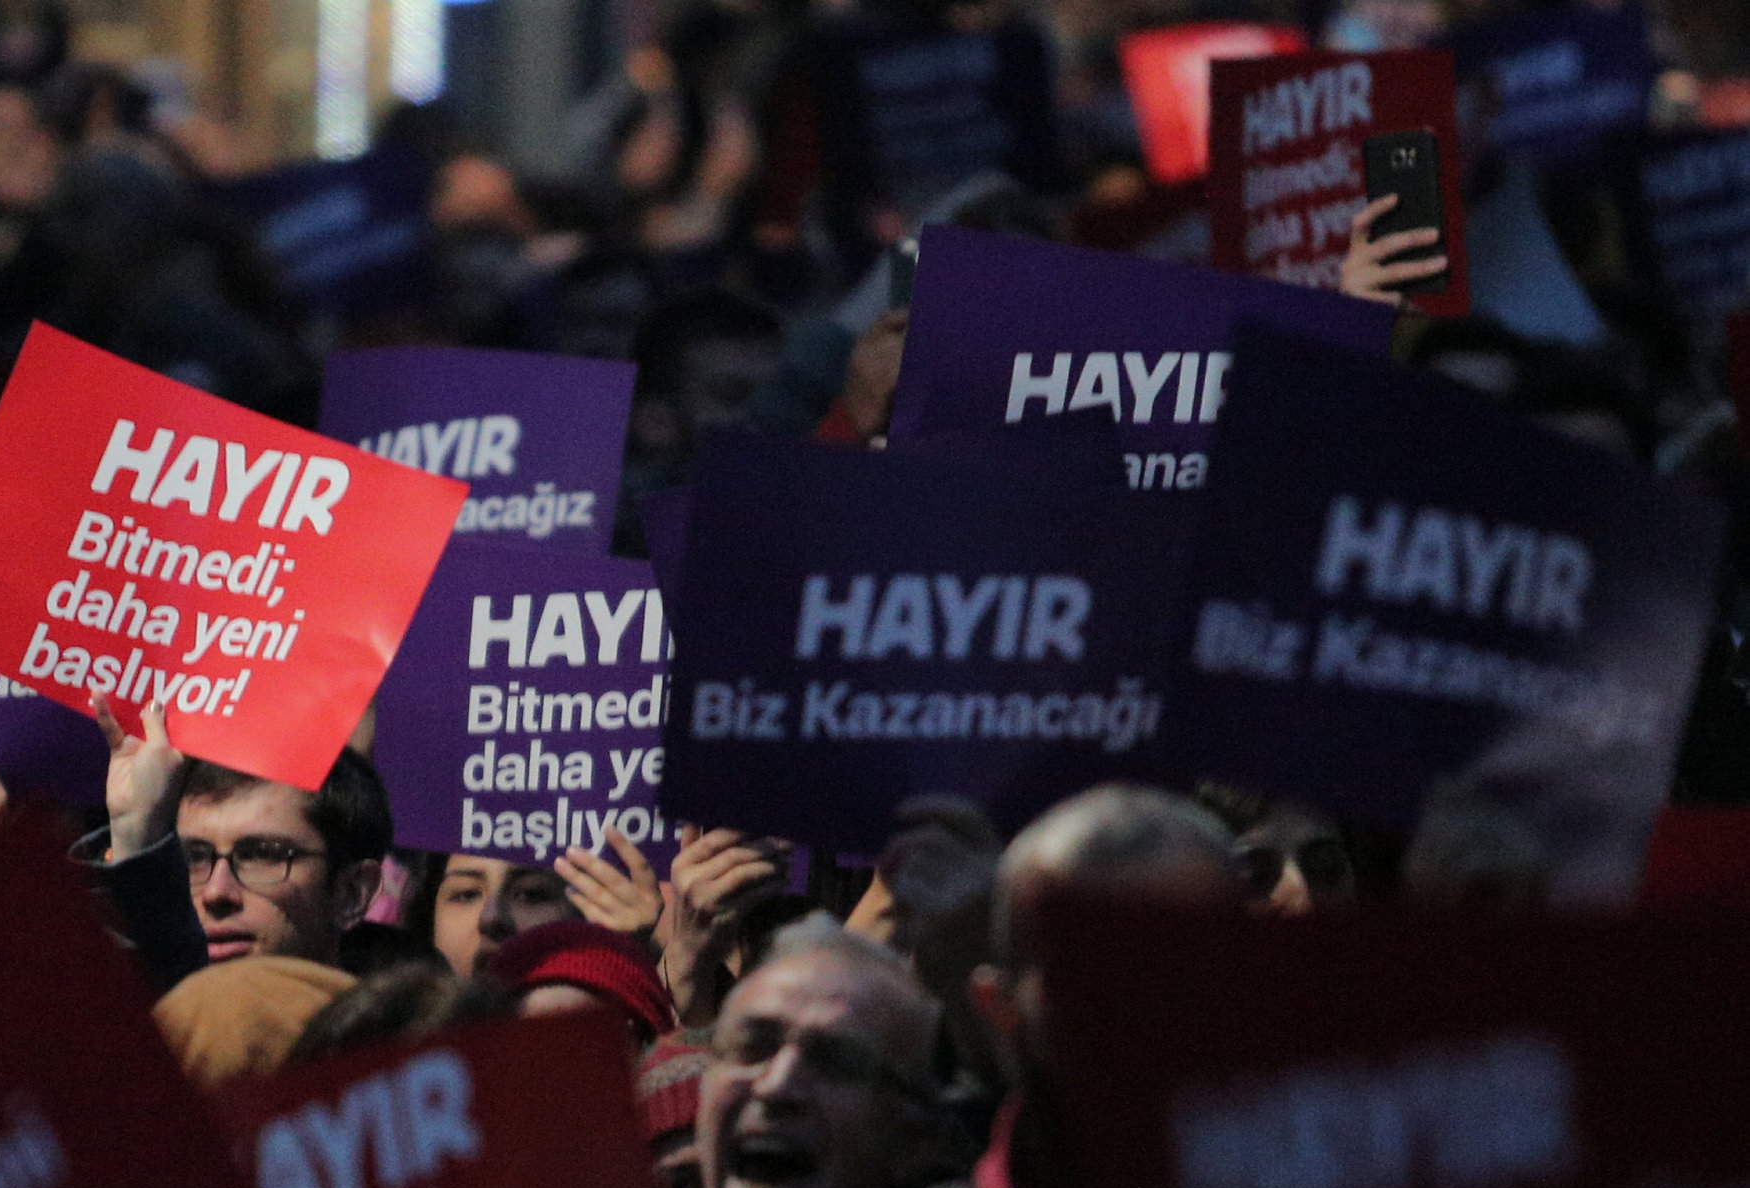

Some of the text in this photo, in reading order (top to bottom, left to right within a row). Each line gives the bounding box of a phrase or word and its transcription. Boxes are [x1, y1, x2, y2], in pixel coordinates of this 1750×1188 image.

[90, 419, 351, 537] HAYIR
[67, 509, 296, 609] Bitmedi;
[1315, 494, 1595, 639] HAYIR
[46, 569, 306, 665] daha yeni
[797, 575, 1092, 661] HAYIR
[692, 677, 788, 740] Biz
[462, 739, 594, 793] daha
